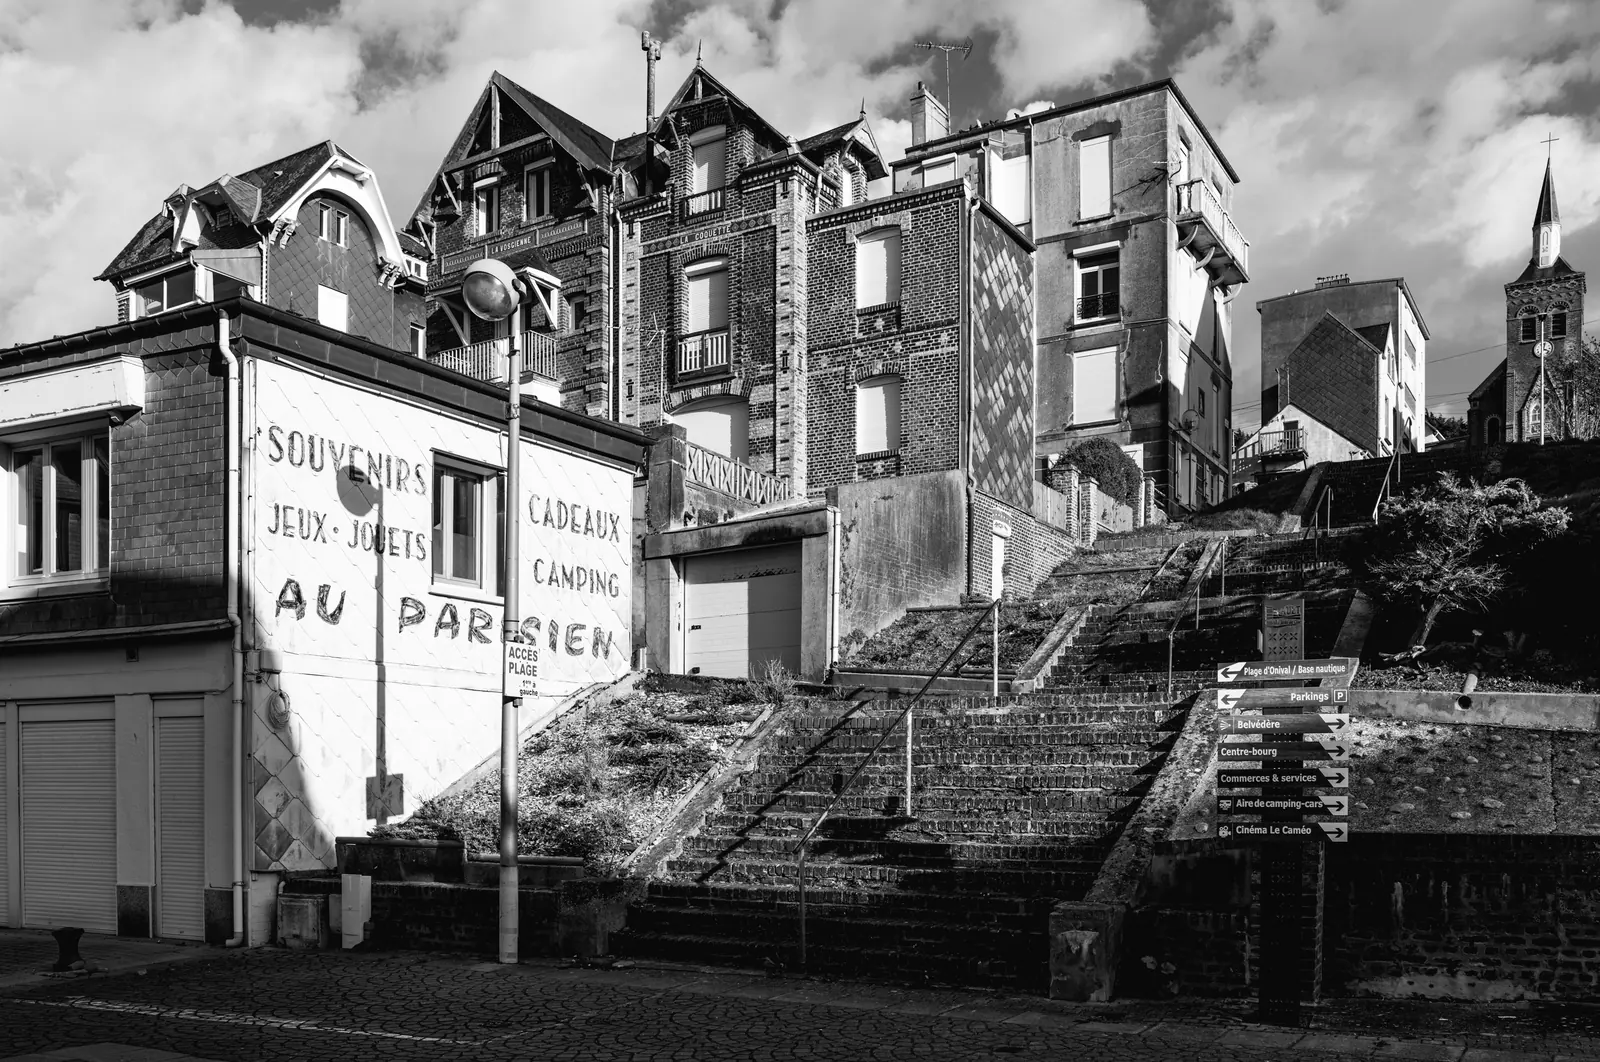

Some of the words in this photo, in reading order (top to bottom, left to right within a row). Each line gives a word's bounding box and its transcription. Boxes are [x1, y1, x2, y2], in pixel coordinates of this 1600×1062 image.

[680, 235, 689, 245] LA
[695, 225, 731, 241] COQUETTE
[491, 246, 499, 255] LA
[500, 236, 532, 252] VOSGIENNE
[267, 425, 428, 497] SOUVENIRS
[528, 493, 621, 544] CADEAUX
[347, 519, 428, 562] JOUETS
[533, 558, 620, 599] CAMPING
[275, 578, 347, 626] AU
[398, 596, 615, 660] PARSIEN
[508, 646, 538, 662] ACCÈS
[508, 661, 538, 678] PLAGE
[1243, 666, 1262, 678] Plage
[1263, 665, 1291, 676] d'Onival
[1298, 664, 1314, 675] Base
[1315, 663, 1346, 675] nautique
[519, 688, 539, 697] gauche
[1290, 692, 1330, 703] Parkings
[1237, 719, 1281, 729] Belvédère
[1220, 747, 1278, 758] Centre-bourg
[1220, 774, 1270, 783] Commerces
[1272, 773, 1280, 783] &
[1281, 773, 1317, 783] services
[1236, 798, 1254, 808] Aire
[1254, 798, 1265, 808] de
[1265, 798, 1324, 810] camping-cars
[1235, 825, 1268, 835] Cinéma
[1269, 825, 1281, 835] Le
[1282, 825, 1312, 835] Caméo
